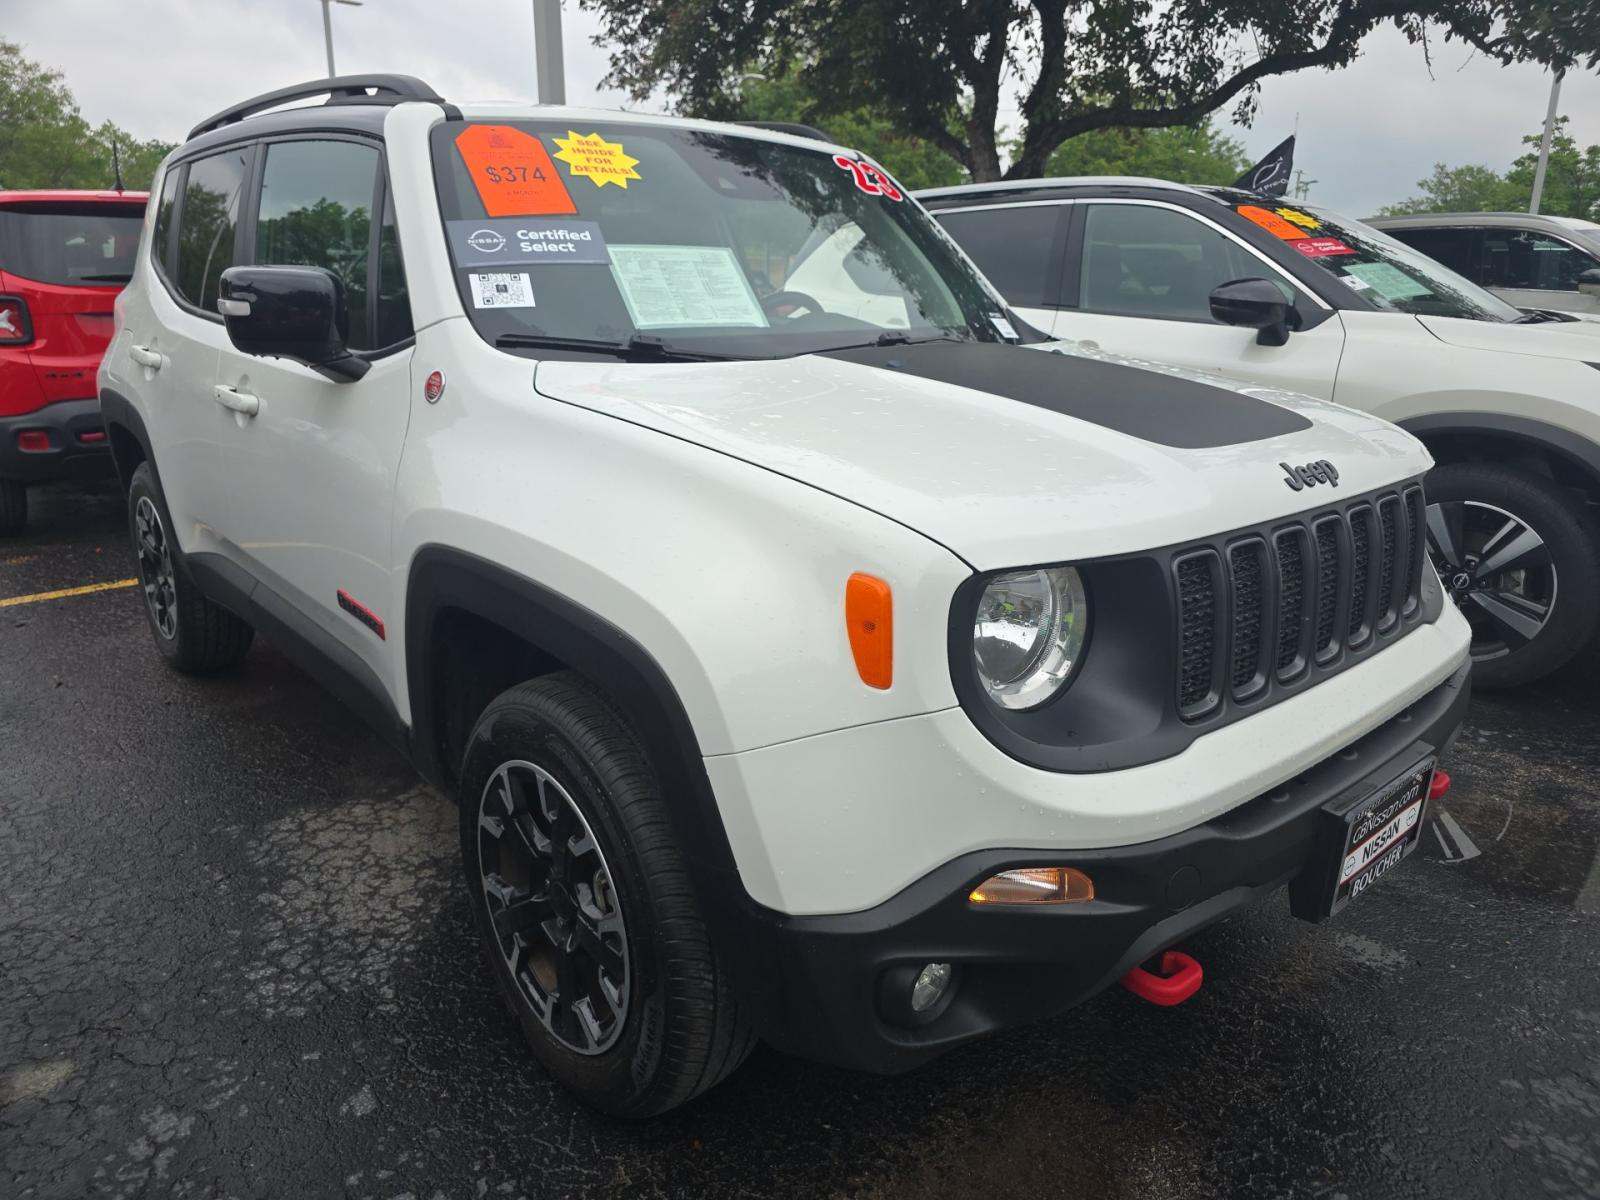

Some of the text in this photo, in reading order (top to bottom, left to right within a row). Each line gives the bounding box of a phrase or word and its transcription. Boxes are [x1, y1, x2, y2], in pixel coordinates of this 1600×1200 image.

[577, 139, 601, 148] SEE
[571, 147, 616, 157] INSIDE
[586, 157, 613, 166] FOR
[486, 166, 547, 185] $374
[574, 164, 632, 176] DETAILS!
[516, 229, 592, 241] Certified
[520, 241, 577, 253] Select
[1279, 459, 1339, 492] Jeep
[1362, 818, 1401, 863] NISSAN
[1351, 844, 1403, 898] BOUCHER
